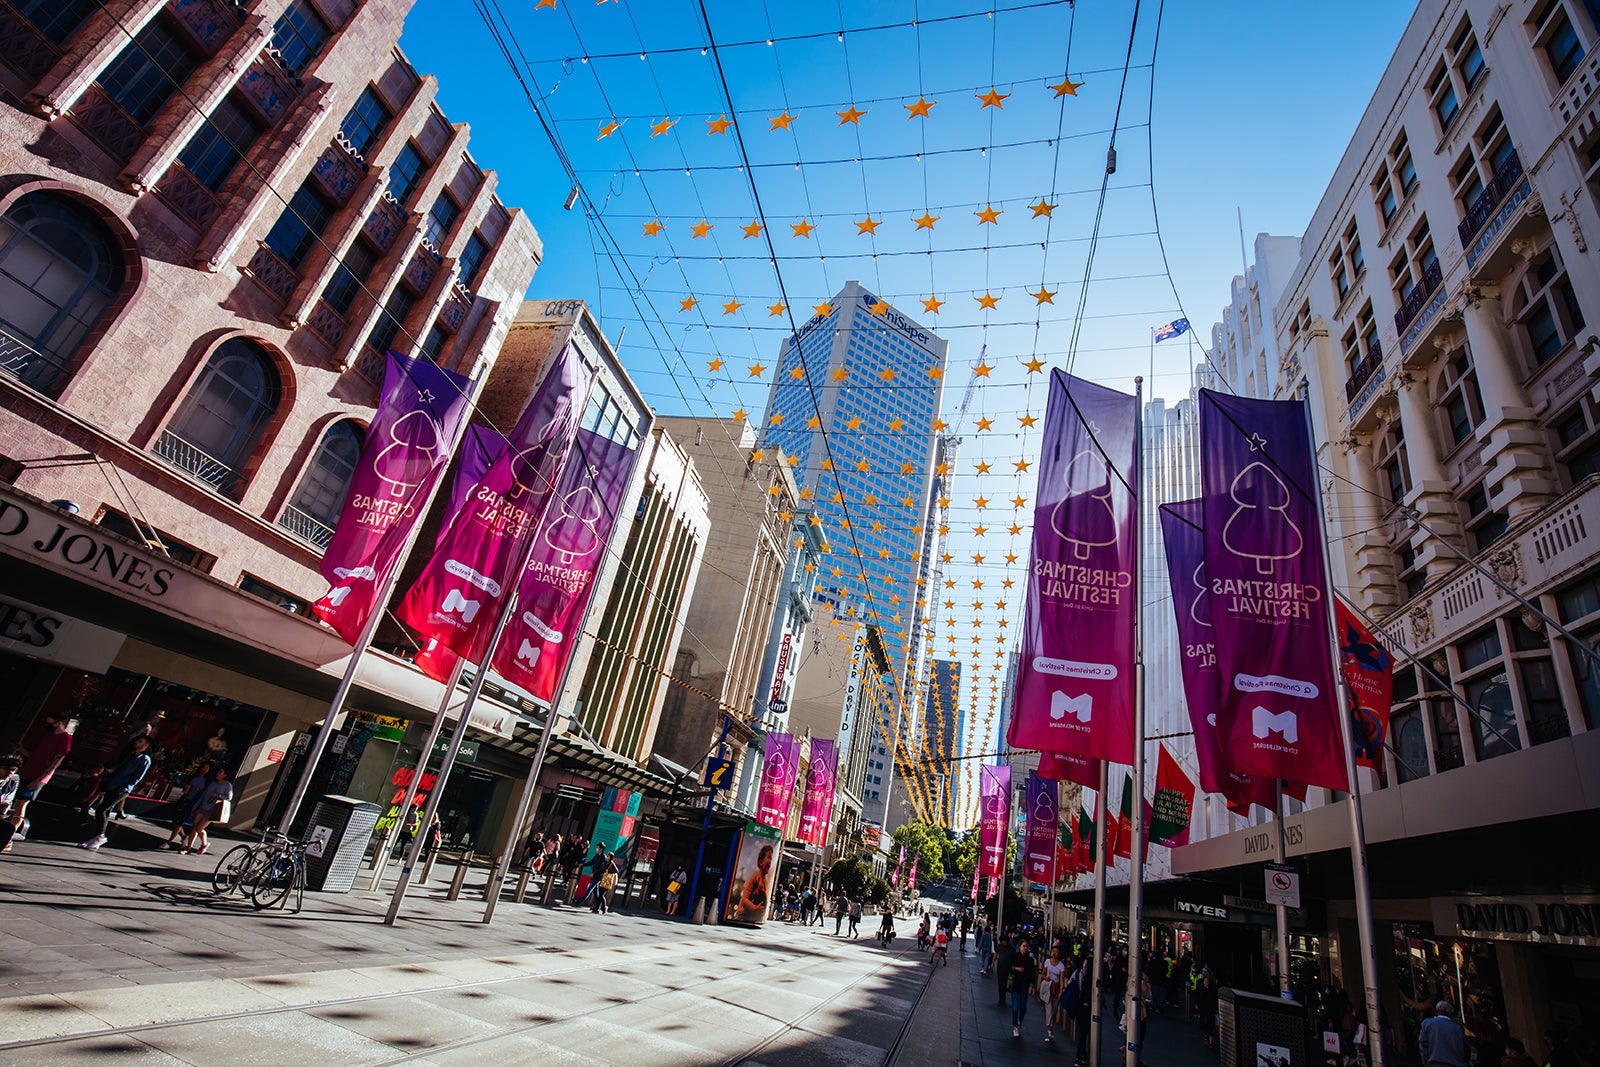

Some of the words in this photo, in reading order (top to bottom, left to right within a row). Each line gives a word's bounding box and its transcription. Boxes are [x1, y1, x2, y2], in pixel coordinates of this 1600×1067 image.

[1473, 191, 1522, 257] LIMITED
[33, 524, 175, 597] JONES
[771, 636, 792, 696] CAUSEWAY
[841, 685, 855, 731] DAVID
[458, 746, 475, 757] Sale
[1244, 833, 1270, 855] DAVID
[1063, 902, 1088, 911] MYER
[1177, 901, 1228, 919] MYER
[1456, 903, 1529, 934] DAVID
